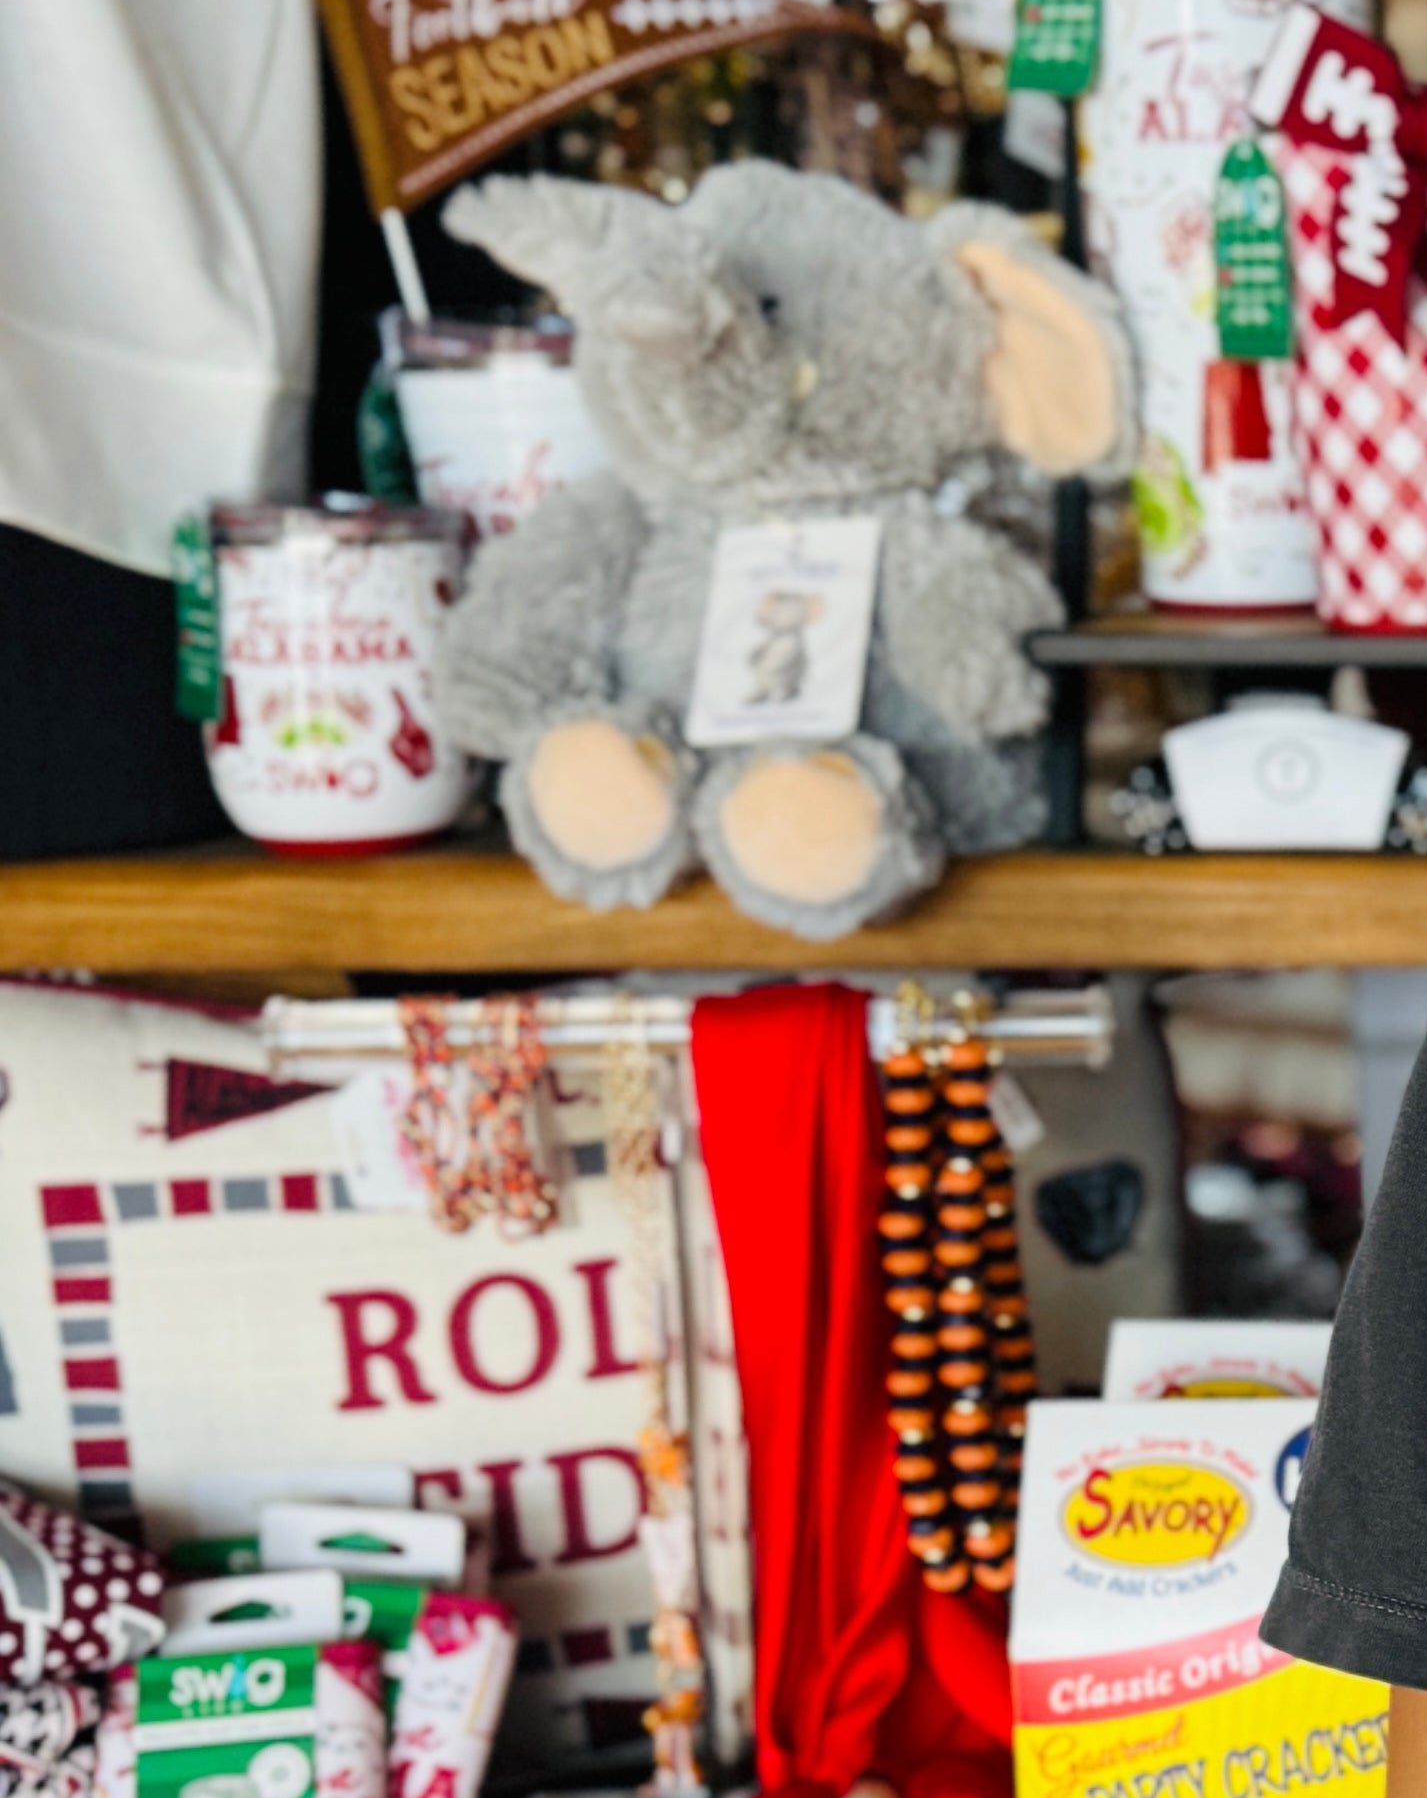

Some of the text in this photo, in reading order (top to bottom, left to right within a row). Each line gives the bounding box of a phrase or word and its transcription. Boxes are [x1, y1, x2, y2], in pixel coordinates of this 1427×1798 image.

[389, 10, 615, 151] SEASON
[326, 1258, 650, 1411] ROL
[1077, 1467, 1240, 1562] SAVORY
[1049, 1669, 1174, 1713] Classic
